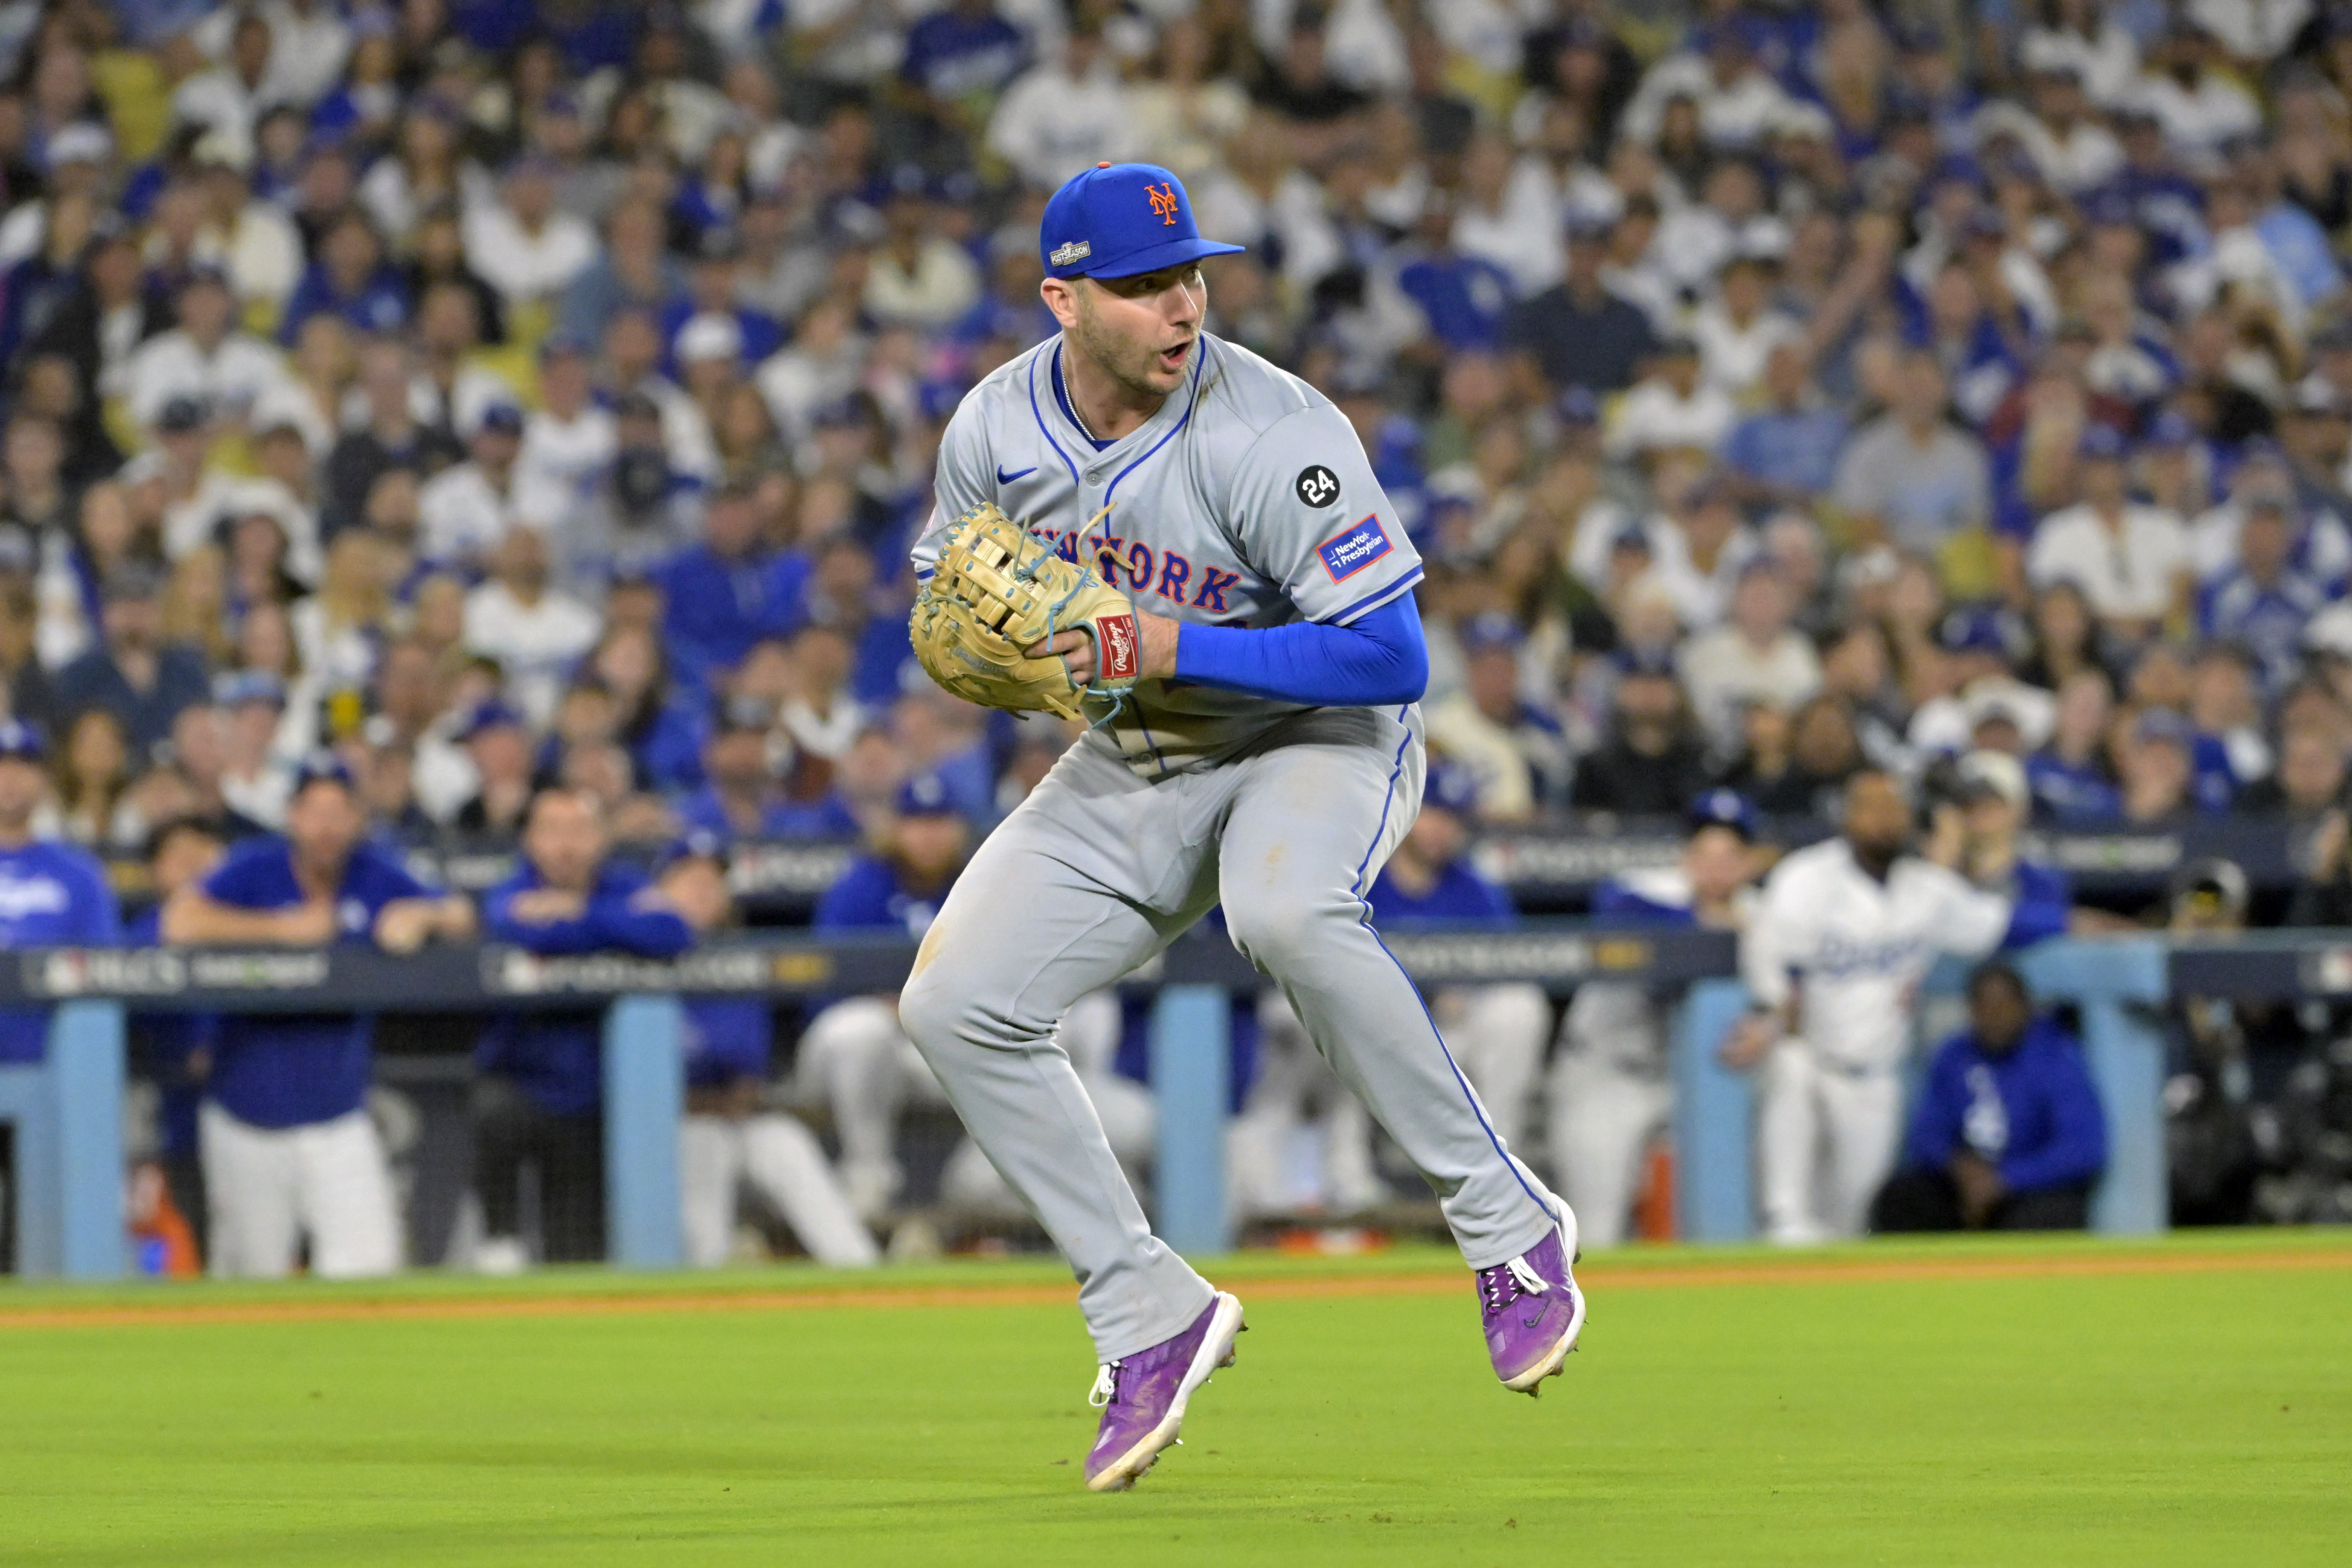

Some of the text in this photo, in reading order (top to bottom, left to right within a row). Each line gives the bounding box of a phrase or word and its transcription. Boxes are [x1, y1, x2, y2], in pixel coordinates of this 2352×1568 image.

[1051, 245, 1088, 264] POSTSEASON
[1302, 470, 1336, 504] 24
[1340, 535, 1384, 565] Presbyterian
[1089, 536, 1241, 612] YORK
[1108, 621, 1127, 671] Rawlings
